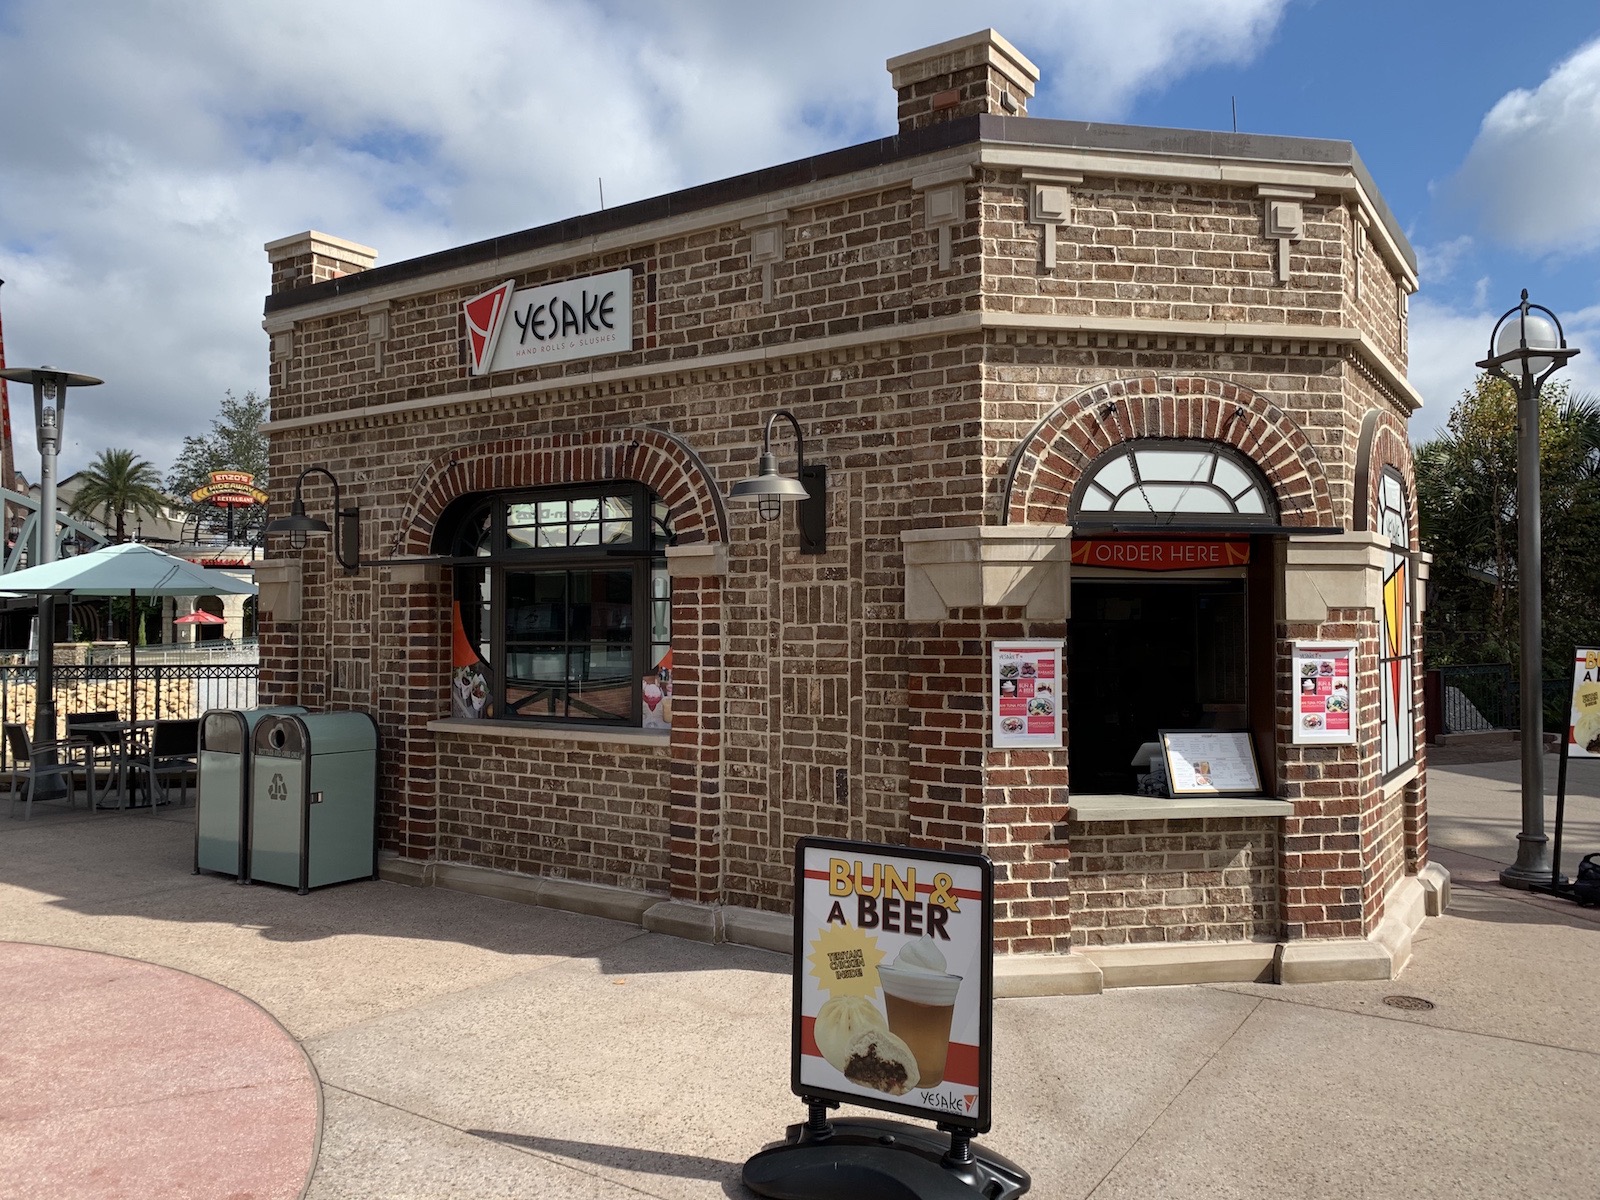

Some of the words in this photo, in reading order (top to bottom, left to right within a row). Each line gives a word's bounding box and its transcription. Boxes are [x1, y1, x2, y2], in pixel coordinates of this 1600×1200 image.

[514, 290, 614, 345] YESAKE
[516, 347, 537, 357] HAND
[541, 342, 566, 352] ROLLS
[580, 334, 616, 346] SLUSHES
[215, 474, 248, 482] ENZO'S
[208, 483, 254, 493] HIDEAWAY
[1096, 544, 1163, 562] ORDER
[1170, 545, 1220, 562] HERE
[828, 857, 916, 902] BUN
[929, 872, 961, 913] &
[826, 900, 847, 926] A
[857, 895, 951, 941] BEER
[827, 948, 863, 962] TERIYAKI
[829, 957, 865, 970] CHICKEN
[835, 968, 863, 980] INSIDE
[920, 1091, 963, 1112] YESAKE
